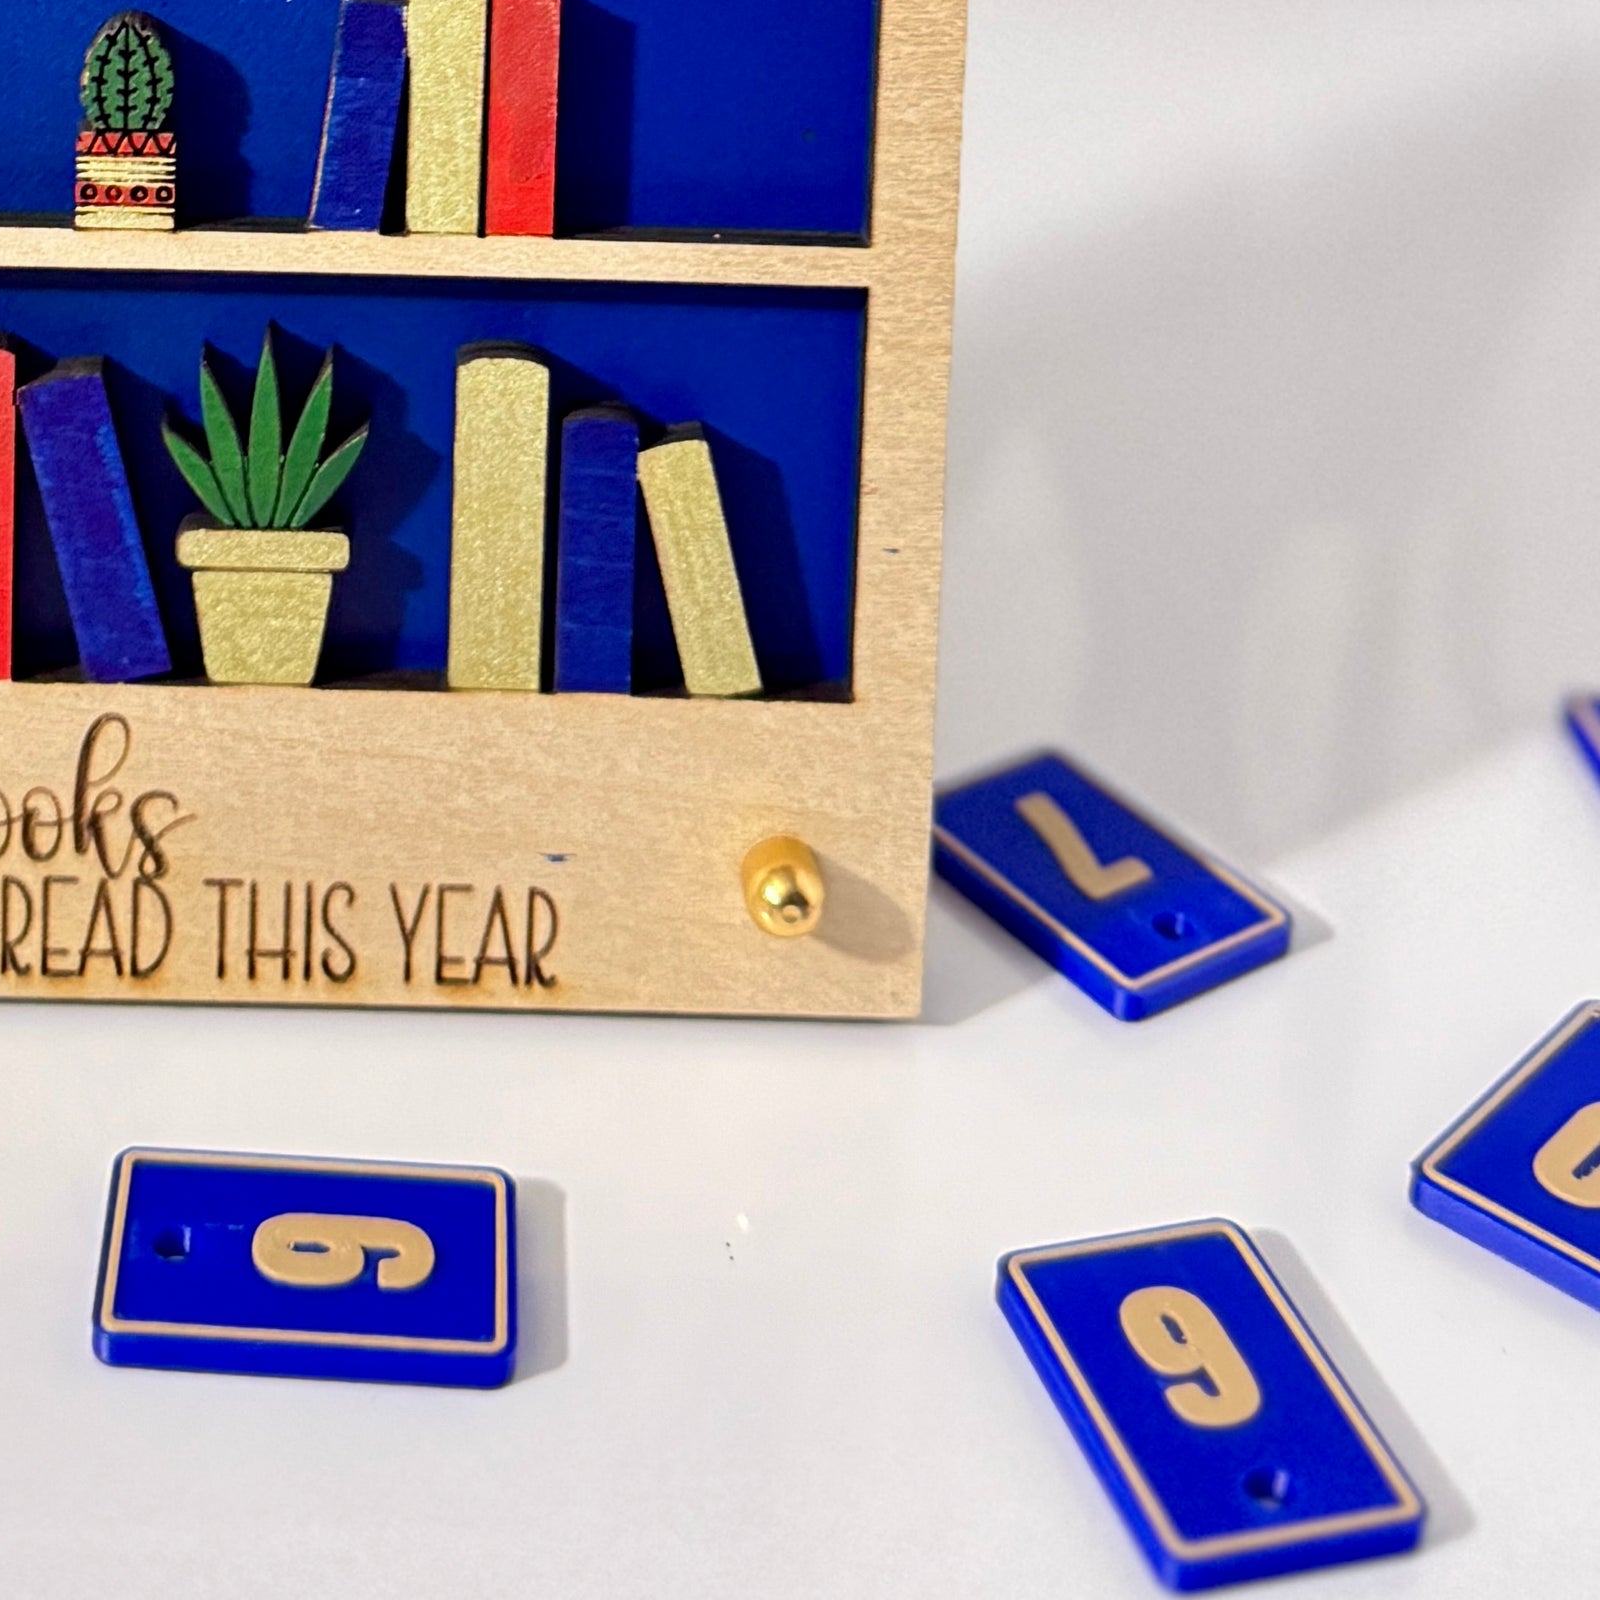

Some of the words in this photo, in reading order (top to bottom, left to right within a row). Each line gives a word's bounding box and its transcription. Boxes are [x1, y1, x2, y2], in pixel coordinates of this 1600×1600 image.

[1013, 791, 1155, 902] 7
[0, 875, 175, 979] READ
[202, 877, 357, 984] THIS
[388, 880, 559, 990] YEAR
